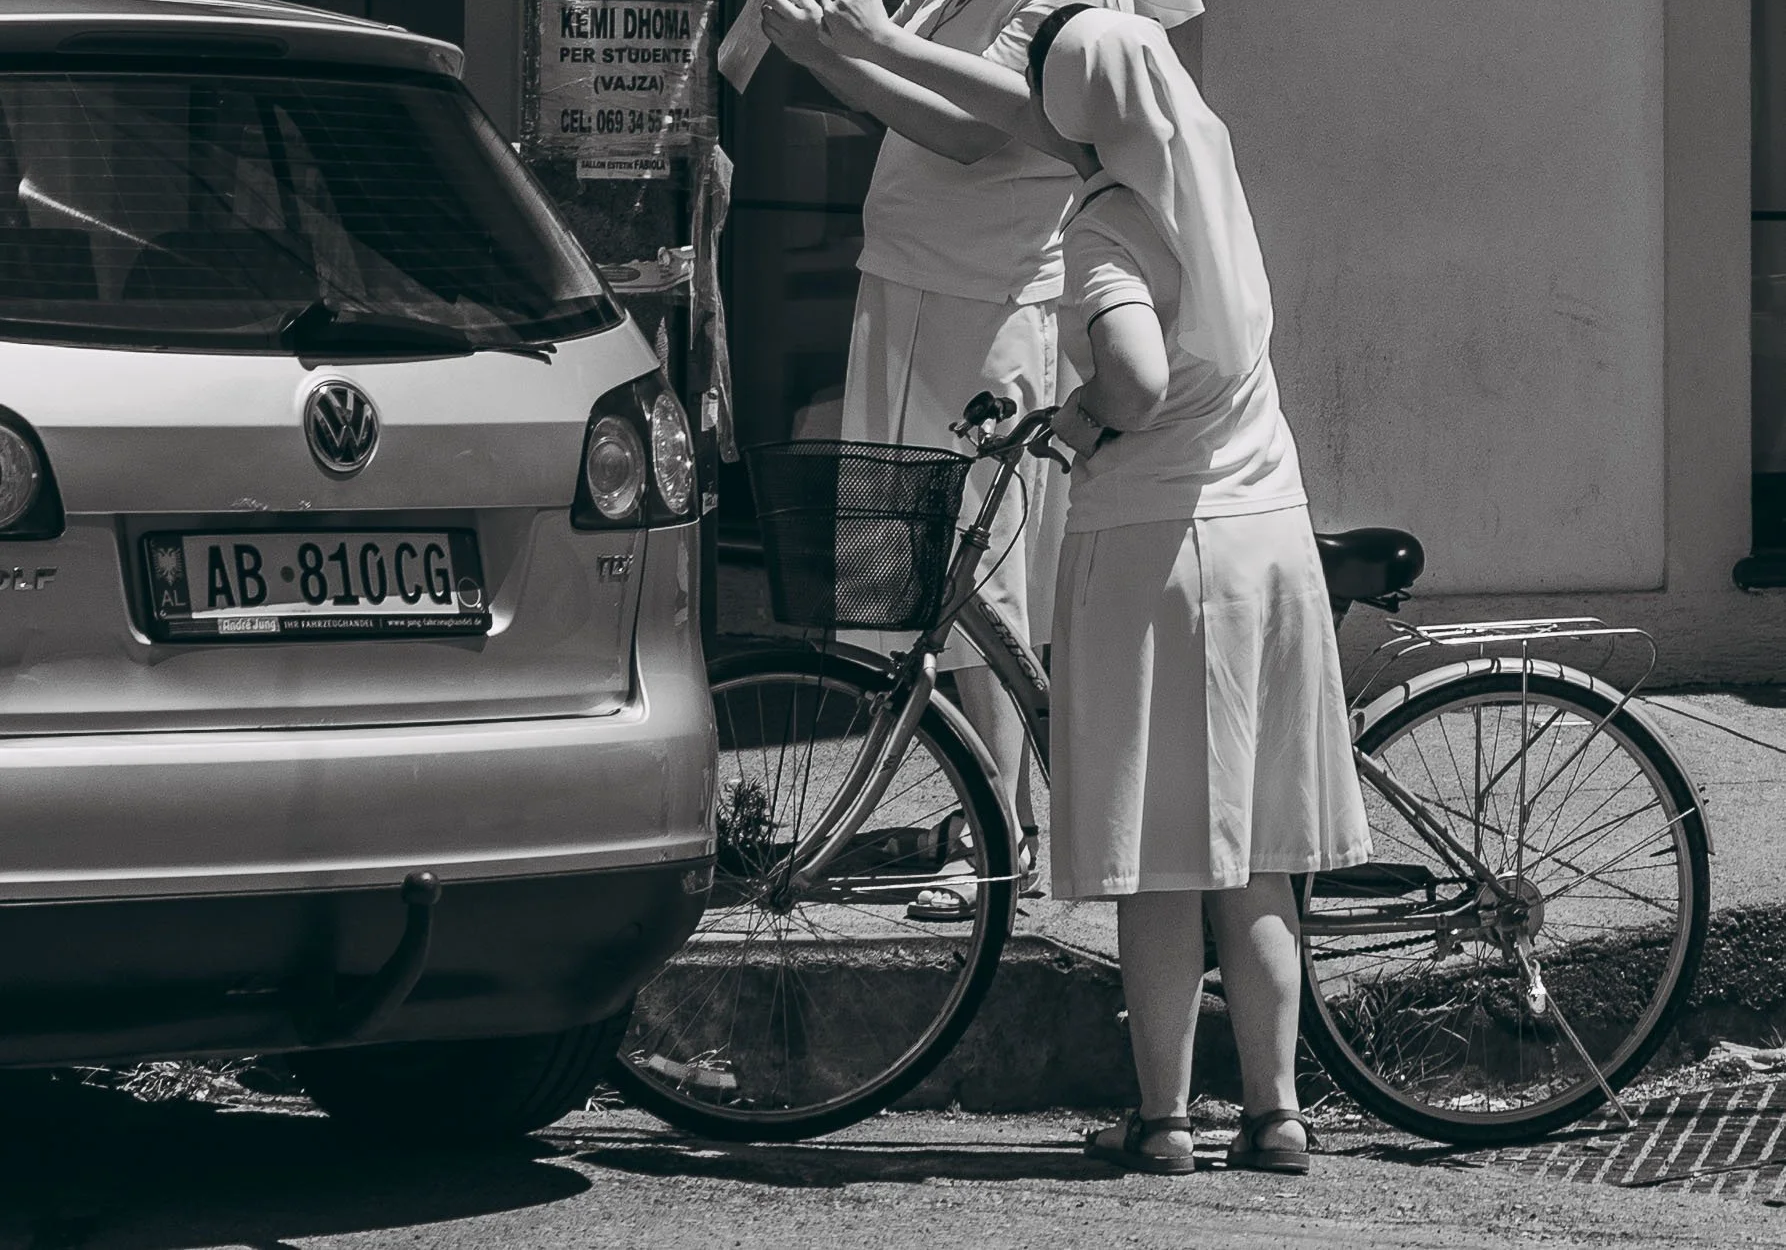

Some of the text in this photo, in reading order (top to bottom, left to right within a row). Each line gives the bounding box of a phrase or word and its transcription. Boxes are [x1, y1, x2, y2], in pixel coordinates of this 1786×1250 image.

[560, 7, 691, 40] KEMI DHOMA
[559, 47, 692, 63] PER STUDENTE
[593, 75, 665, 95] (VAJZA)
[560, 108, 592, 134] CEL:
[596, 109, 624, 134] 069
[628, 109, 644, 134] 34
[161, 589, 187, 608] AL
[222, 617, 251, 632] André
[253, 617, 277, 632] Jung
